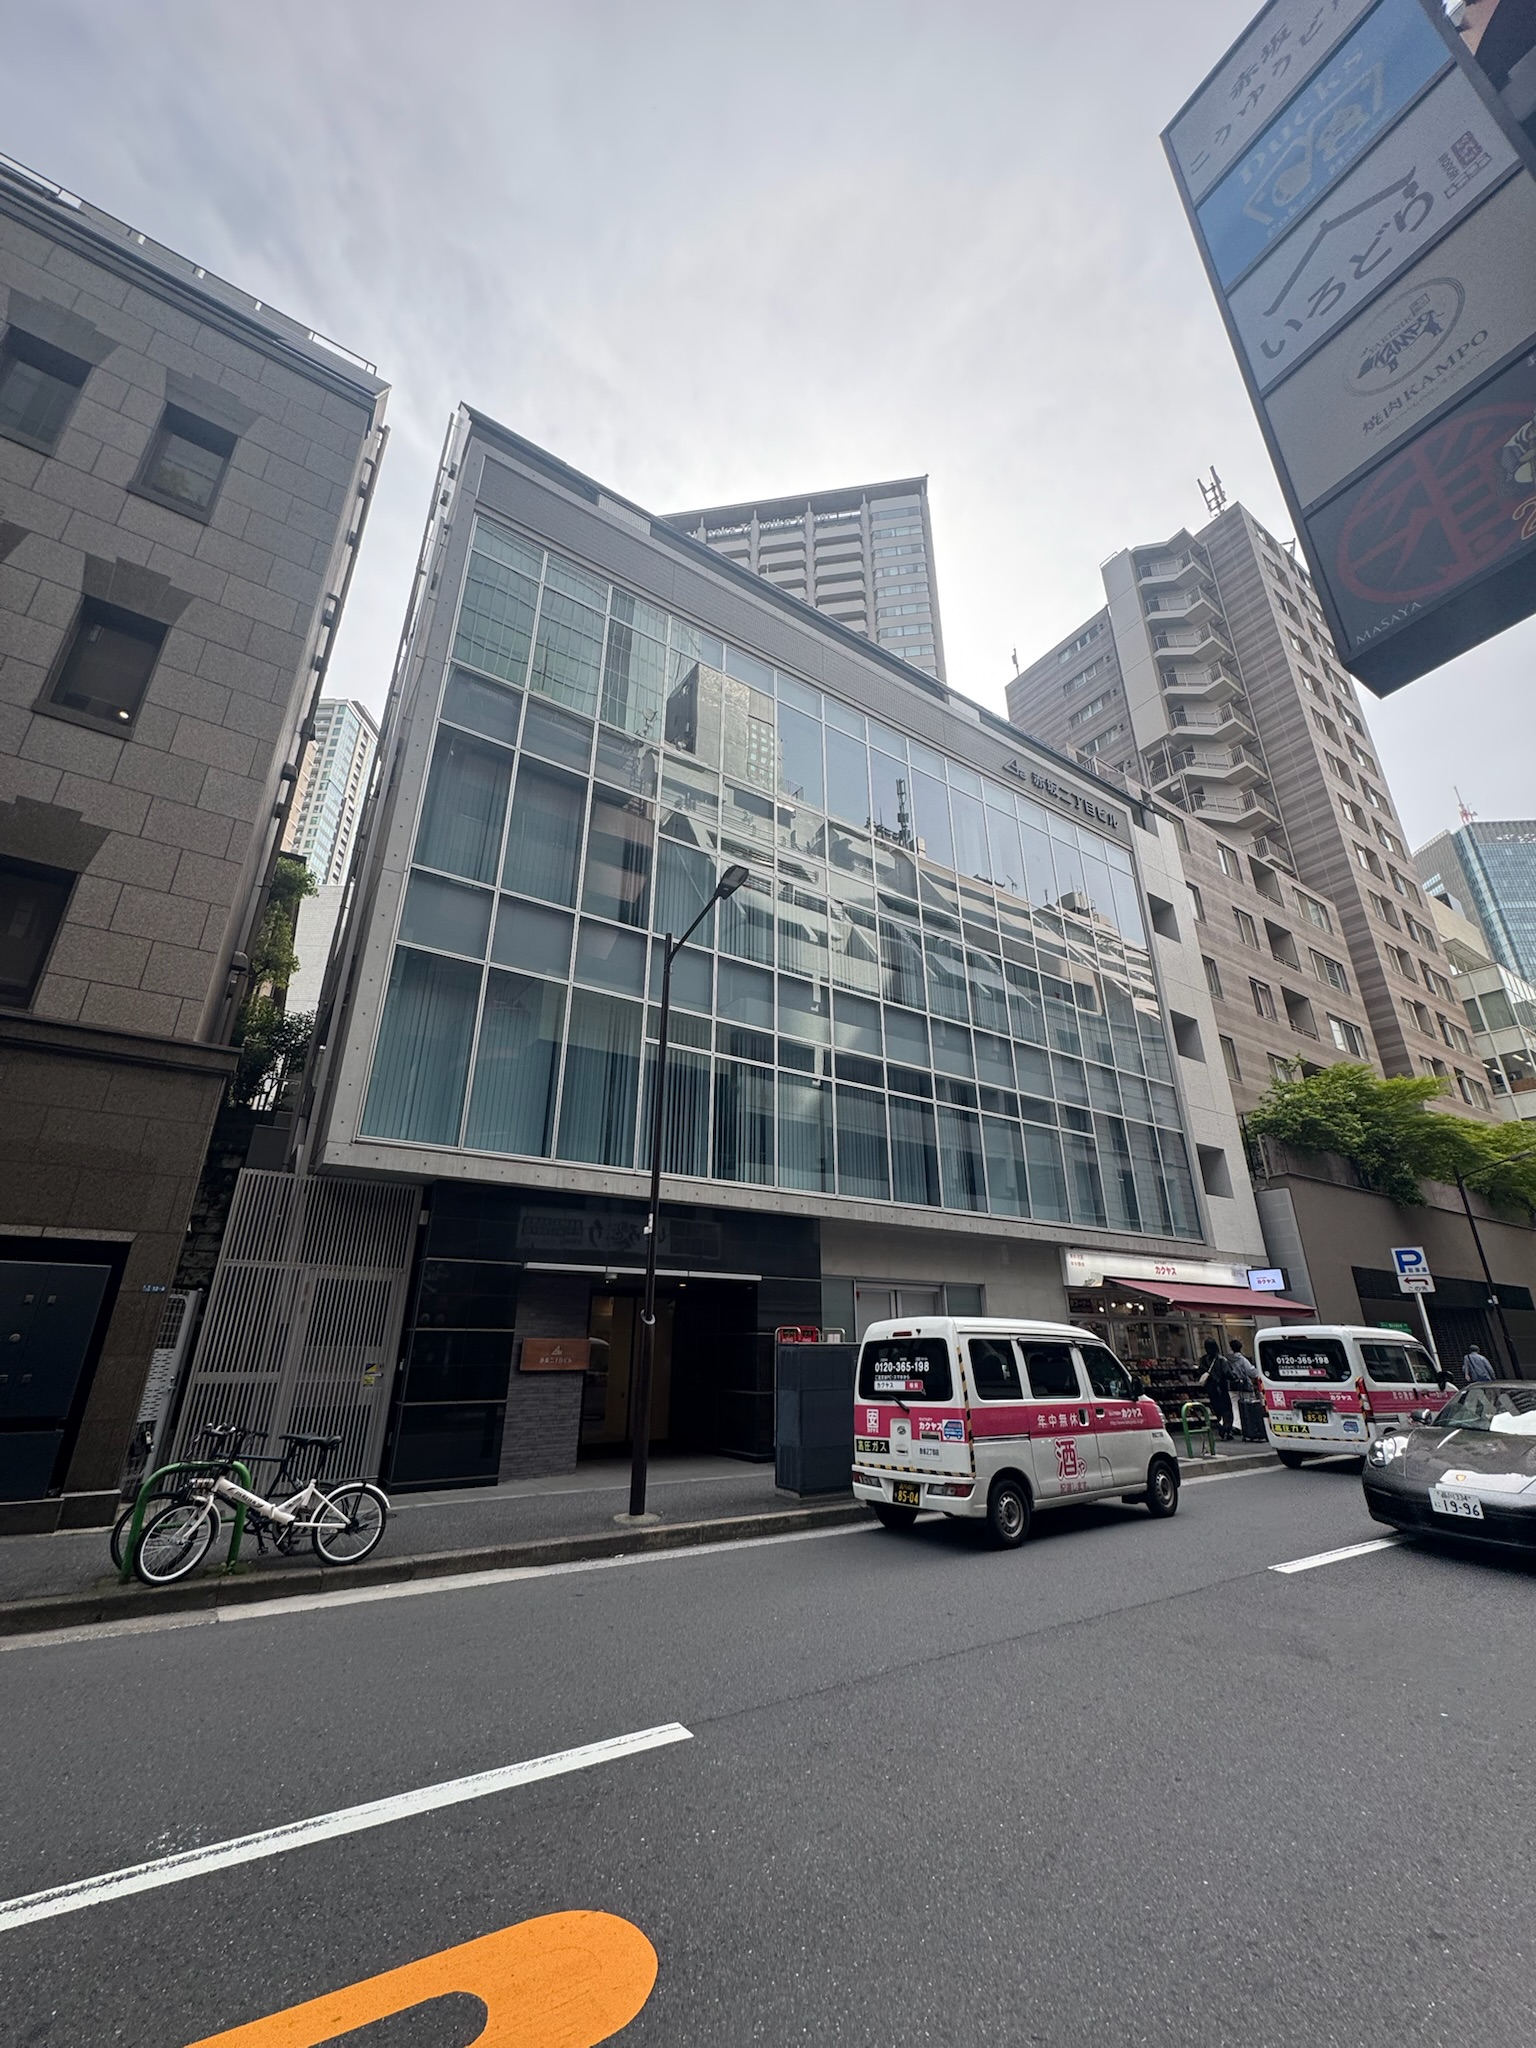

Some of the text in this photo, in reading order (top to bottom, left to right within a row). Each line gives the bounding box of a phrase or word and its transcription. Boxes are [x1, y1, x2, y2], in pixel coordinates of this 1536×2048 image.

[1229, 22, 1293, 101] 赤坂
[1190, 0, 1341, 175] こうゆうビ
[1238, 49, 1364, 185] Ducks
[1260, 178, 1435, 359] いろどり
[1356, 601, 1422, 645] MASAYA
[1395, 1249, 1422, 1273] P
[1154, 1265, 1177, 1276] カクヤス
[874, 1361, 930, 1373] 0120-365-198
[1276, 1356, 1330, 1364] 0120-365-198
[1037, 1413, 1078, 1429] 年中無休
[1121, 1408, 1143, 1418] カクヤス
[1306, 1413, 1328, 1422] 85-02
[918, 1421, 943, 1431] カクヤス
[1274, 1425, 1308, 1433] 高圧ガス
[857, 1440, 888, 1452] 高圧ガス
[1055, 1438, 1086, 1479] 酒や
[897, 1489, 919, 1505] 85-04
[1443, 1499, 1480, 1516] 19-96
